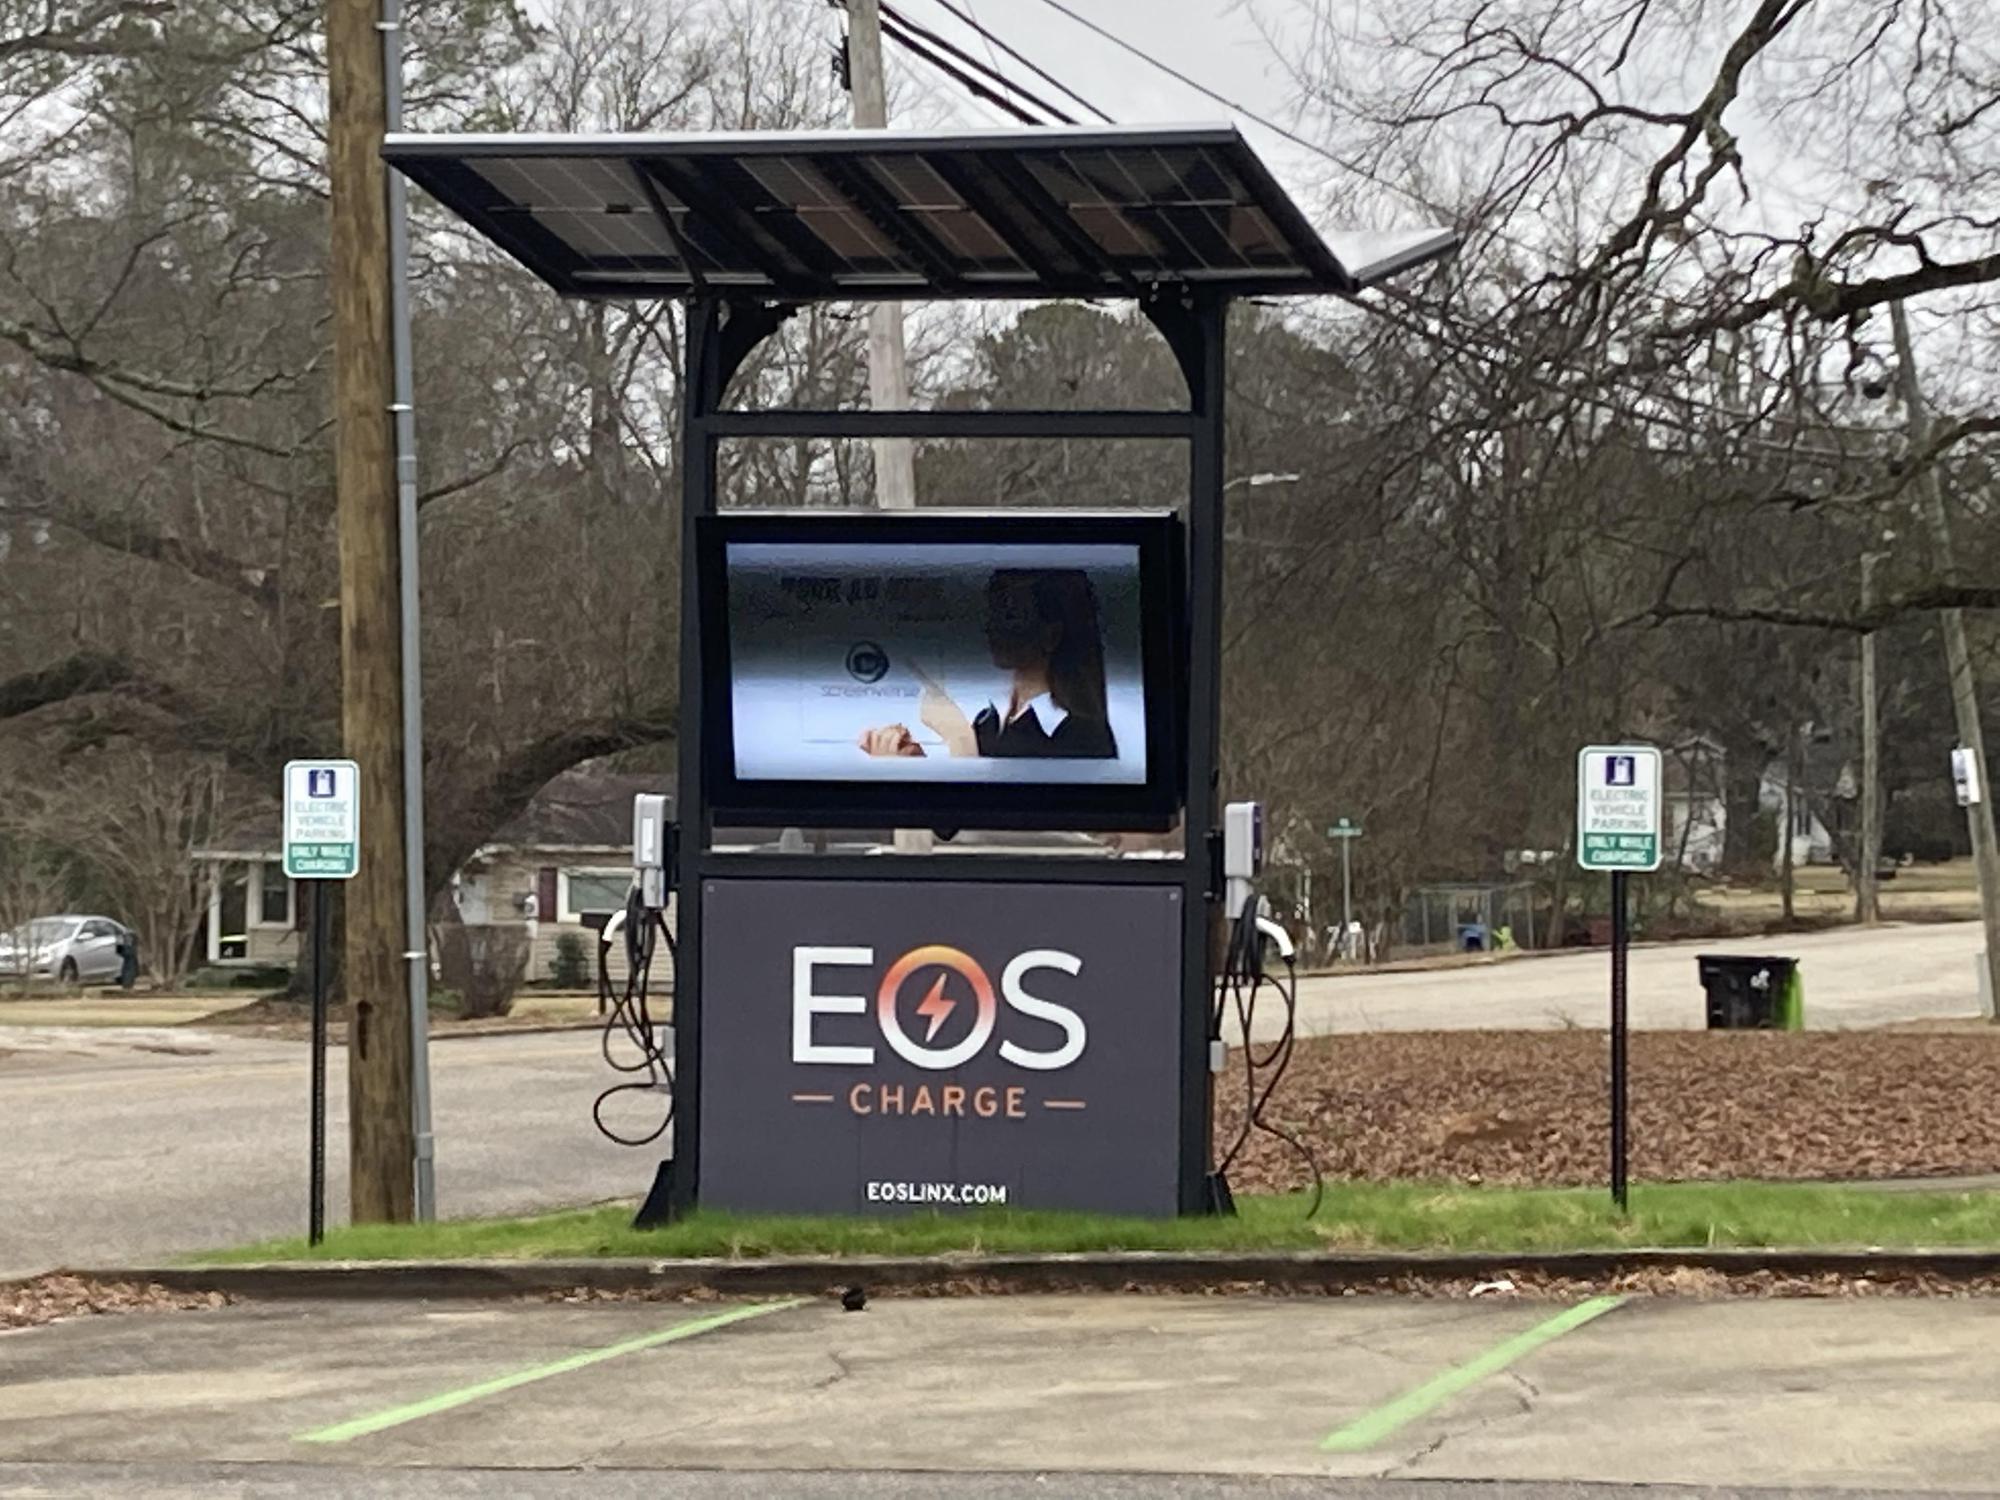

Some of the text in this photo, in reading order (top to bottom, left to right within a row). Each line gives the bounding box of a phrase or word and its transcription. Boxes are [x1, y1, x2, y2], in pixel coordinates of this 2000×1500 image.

[1590, 789, 1648, 802] ELECTRIC
[294, 801, 348, 813] ELECTRIC
[1592, 804, 1647, 816] VEHICLE
[297, 815, 346, 826] VEHICLE
[1591, 818, 1648, 830] PARKING
[295, 828, 346, 839] PARKING
[1587, 835, 1652, 850] ONLY WHILE
[291, 845, 318, 858] ONLY
[1591, 850, 1648, 864] CHARGING
[793, 945, 1087, 1070] EOS
[850, 1082, 1027, 1118] CHARGE
[866, 1181, 1007, 1204] EOSLINX.COM
